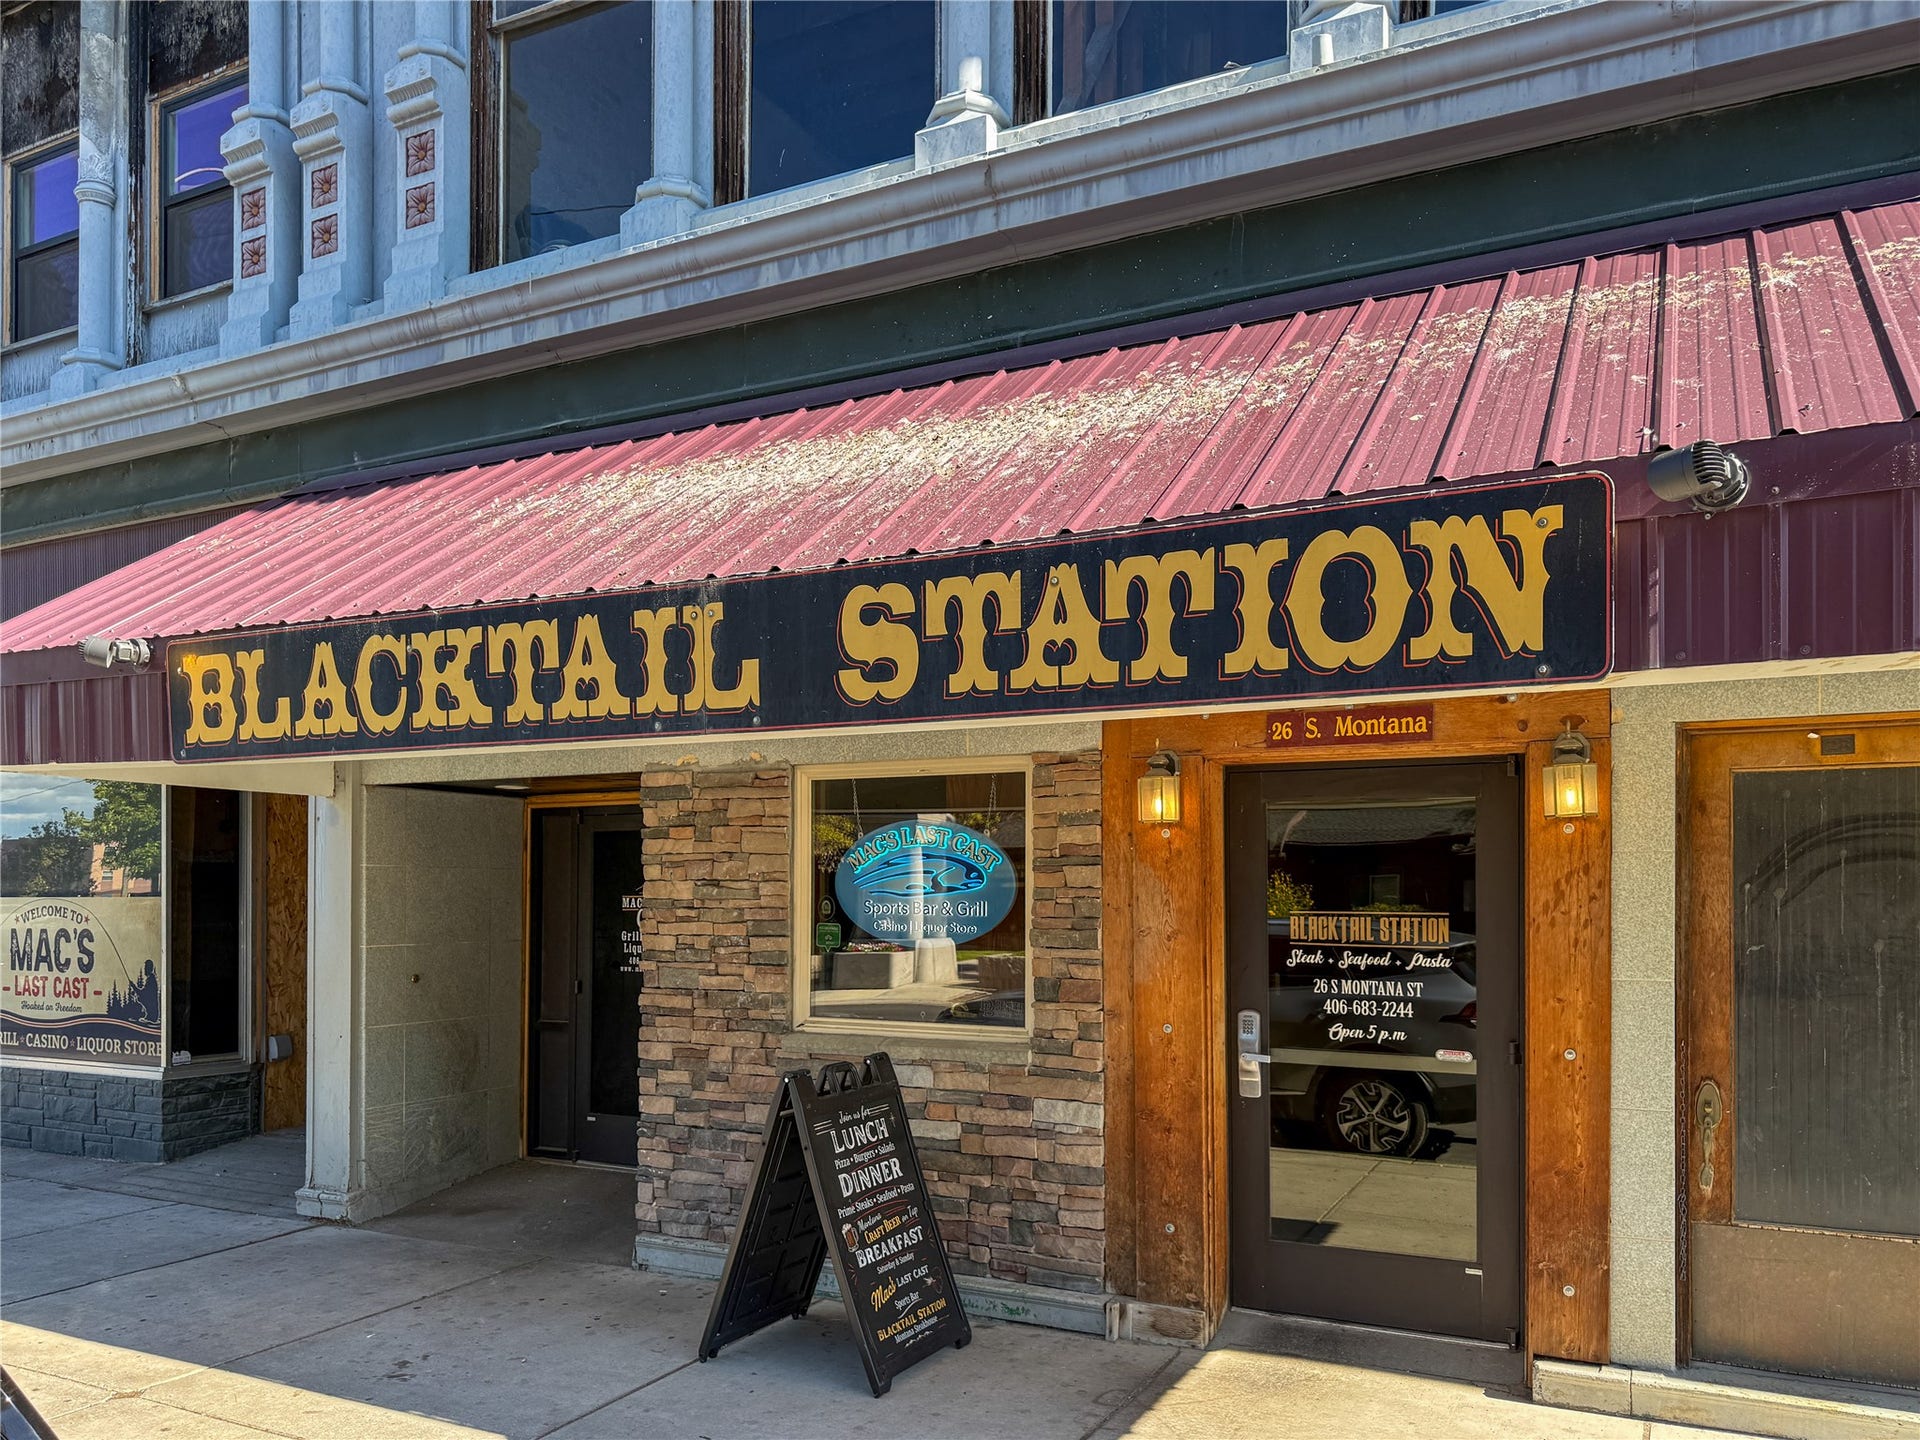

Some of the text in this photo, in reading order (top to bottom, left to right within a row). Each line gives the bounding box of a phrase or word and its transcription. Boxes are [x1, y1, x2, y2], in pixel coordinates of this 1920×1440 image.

[182, 504, 1565, 744] BLACKTAIL STATION
[1272, 715, 1428, 740] 26 S. Montana
[900, 826, 951, 847] LAST
[952, 833, 1002, 872] CAST
[21, 906, 83, 924] WELCOME TO
[865, 900, 988, 917] Sports Bar & Grill
[874, 920, 978, 934] Casino Liquor Store
[1290, 916, 1450, 945] BLACKTAIL STATION
[10, 928, 95, 973] MAC'S
[623, 943, 645, 955] Liqu
[1286, 949, 1453, 971] Steak Seafood Pasta
[15, 975, 89, 999] LAST CAST
[1313, 979, 1424, 998] 26 S MONTANA ST
[21, 1001, 45, 1011] Hooked
[55, 1001, 82, 1013] Freedom
[1323, 999, 1414, 1018] 406-683-2244
[26, 1033, 69, 1049] CASINO
[76, 1037, 120, 1054] LIQUOR
[1328, 1023, 1365, 1042] Open
[1366, 1025, 1378, 1039] 5
[861, 1105, 871, 1120] for
[830, 1118, 889, 1153] LUNCH
[835, 1142, 895, 1169] Pizza Burgers Salads
[838, 1157, 903, 1198] DINNER
[837, 1183, 915, 1218] Prime Steaks Seafood Pasta
[864, 1224, 885, 1244] CRAFT
[883, 1216, 901, 1232] BEER
[907, 1205, 918, 1217] Tap
[855, 1226, 923, 1268] BREAKFAST
[896, 1273, 912, 1287] LAST
[913, 1265, 928, 1278] CAST
[895, 1292, 919, 1310] Sports Bar
[877, 1298, 946, 1341] BLACKTAIL STATION
